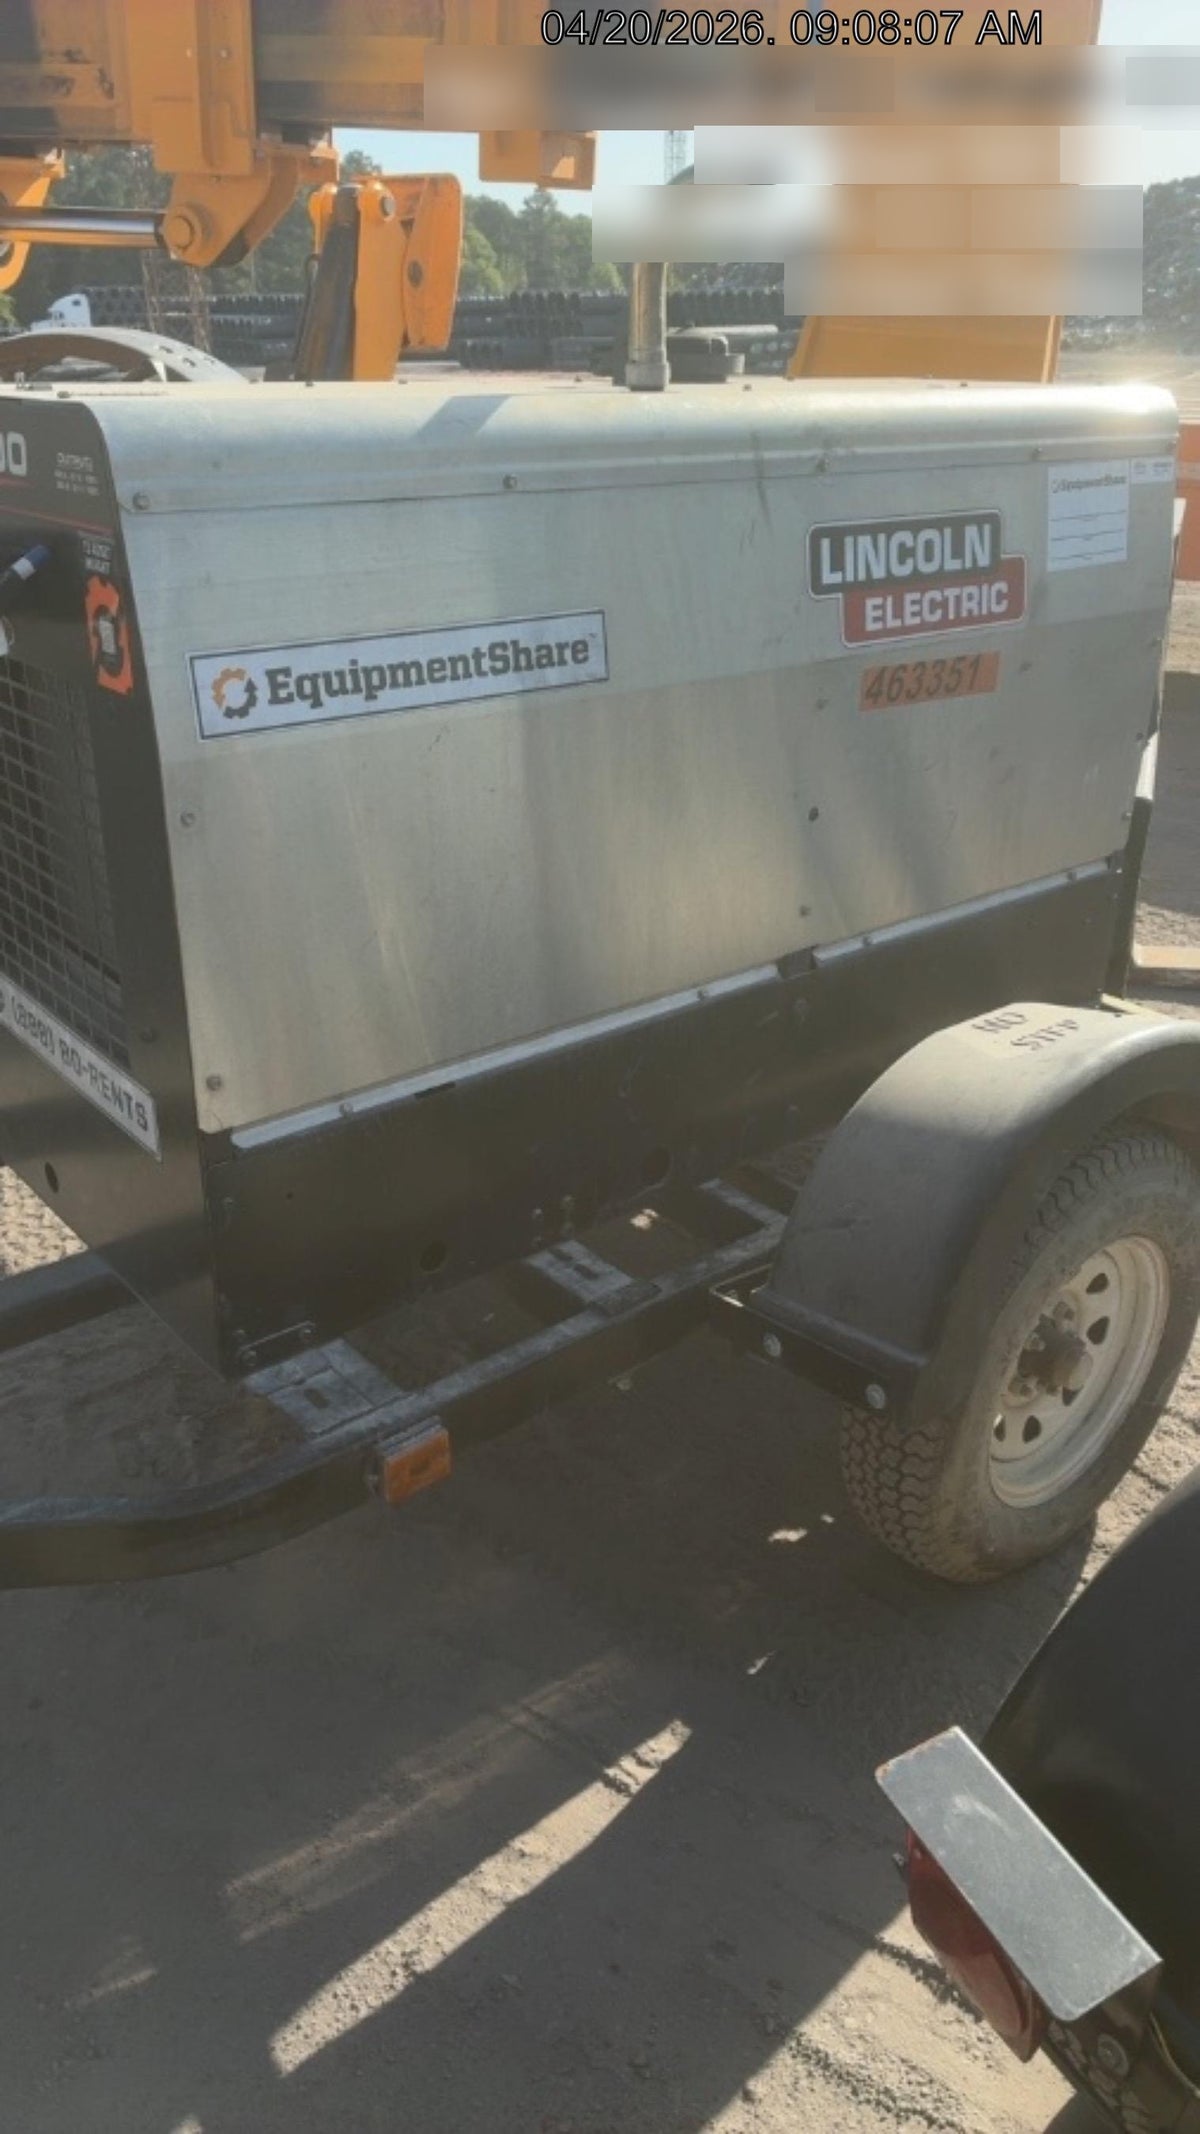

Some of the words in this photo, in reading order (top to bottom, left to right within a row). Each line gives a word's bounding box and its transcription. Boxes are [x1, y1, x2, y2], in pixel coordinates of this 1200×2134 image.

[820, 523, 991, 584] LINCOLN
[865, 581, 1009, 632] ELECTRIC
[265, 638, 590, 709] EquipmentShare
[865, 655, 982, 705] 463351
